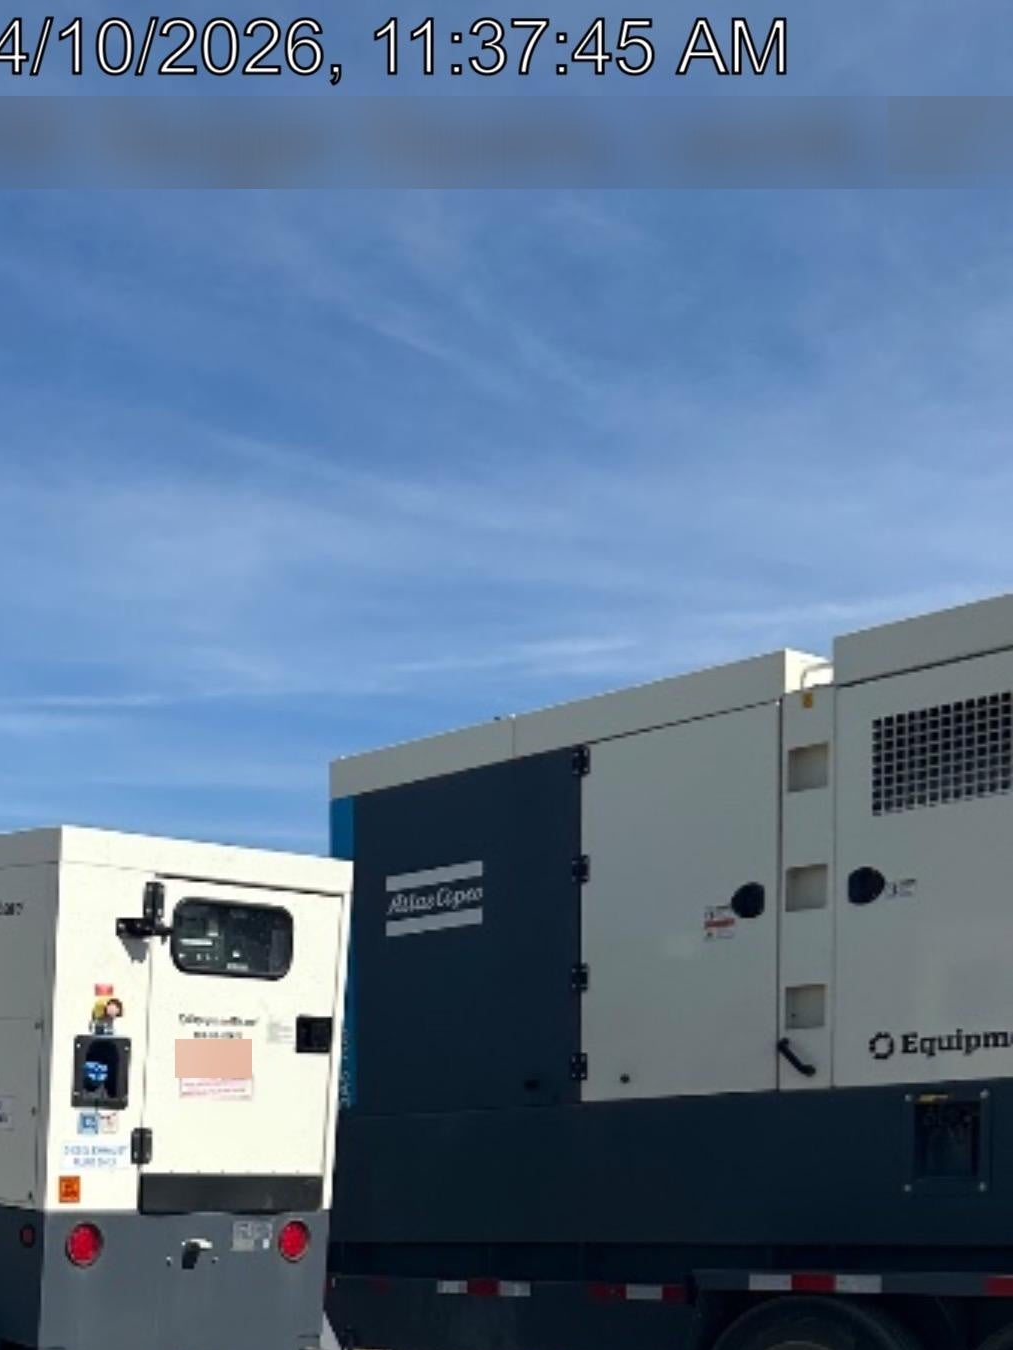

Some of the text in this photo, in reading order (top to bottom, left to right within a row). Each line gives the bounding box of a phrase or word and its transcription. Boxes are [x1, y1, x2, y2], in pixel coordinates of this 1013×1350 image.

[386, 886, 483, 916] Atlas Copco
[901, 1027, 1013, 1058] Equipm
